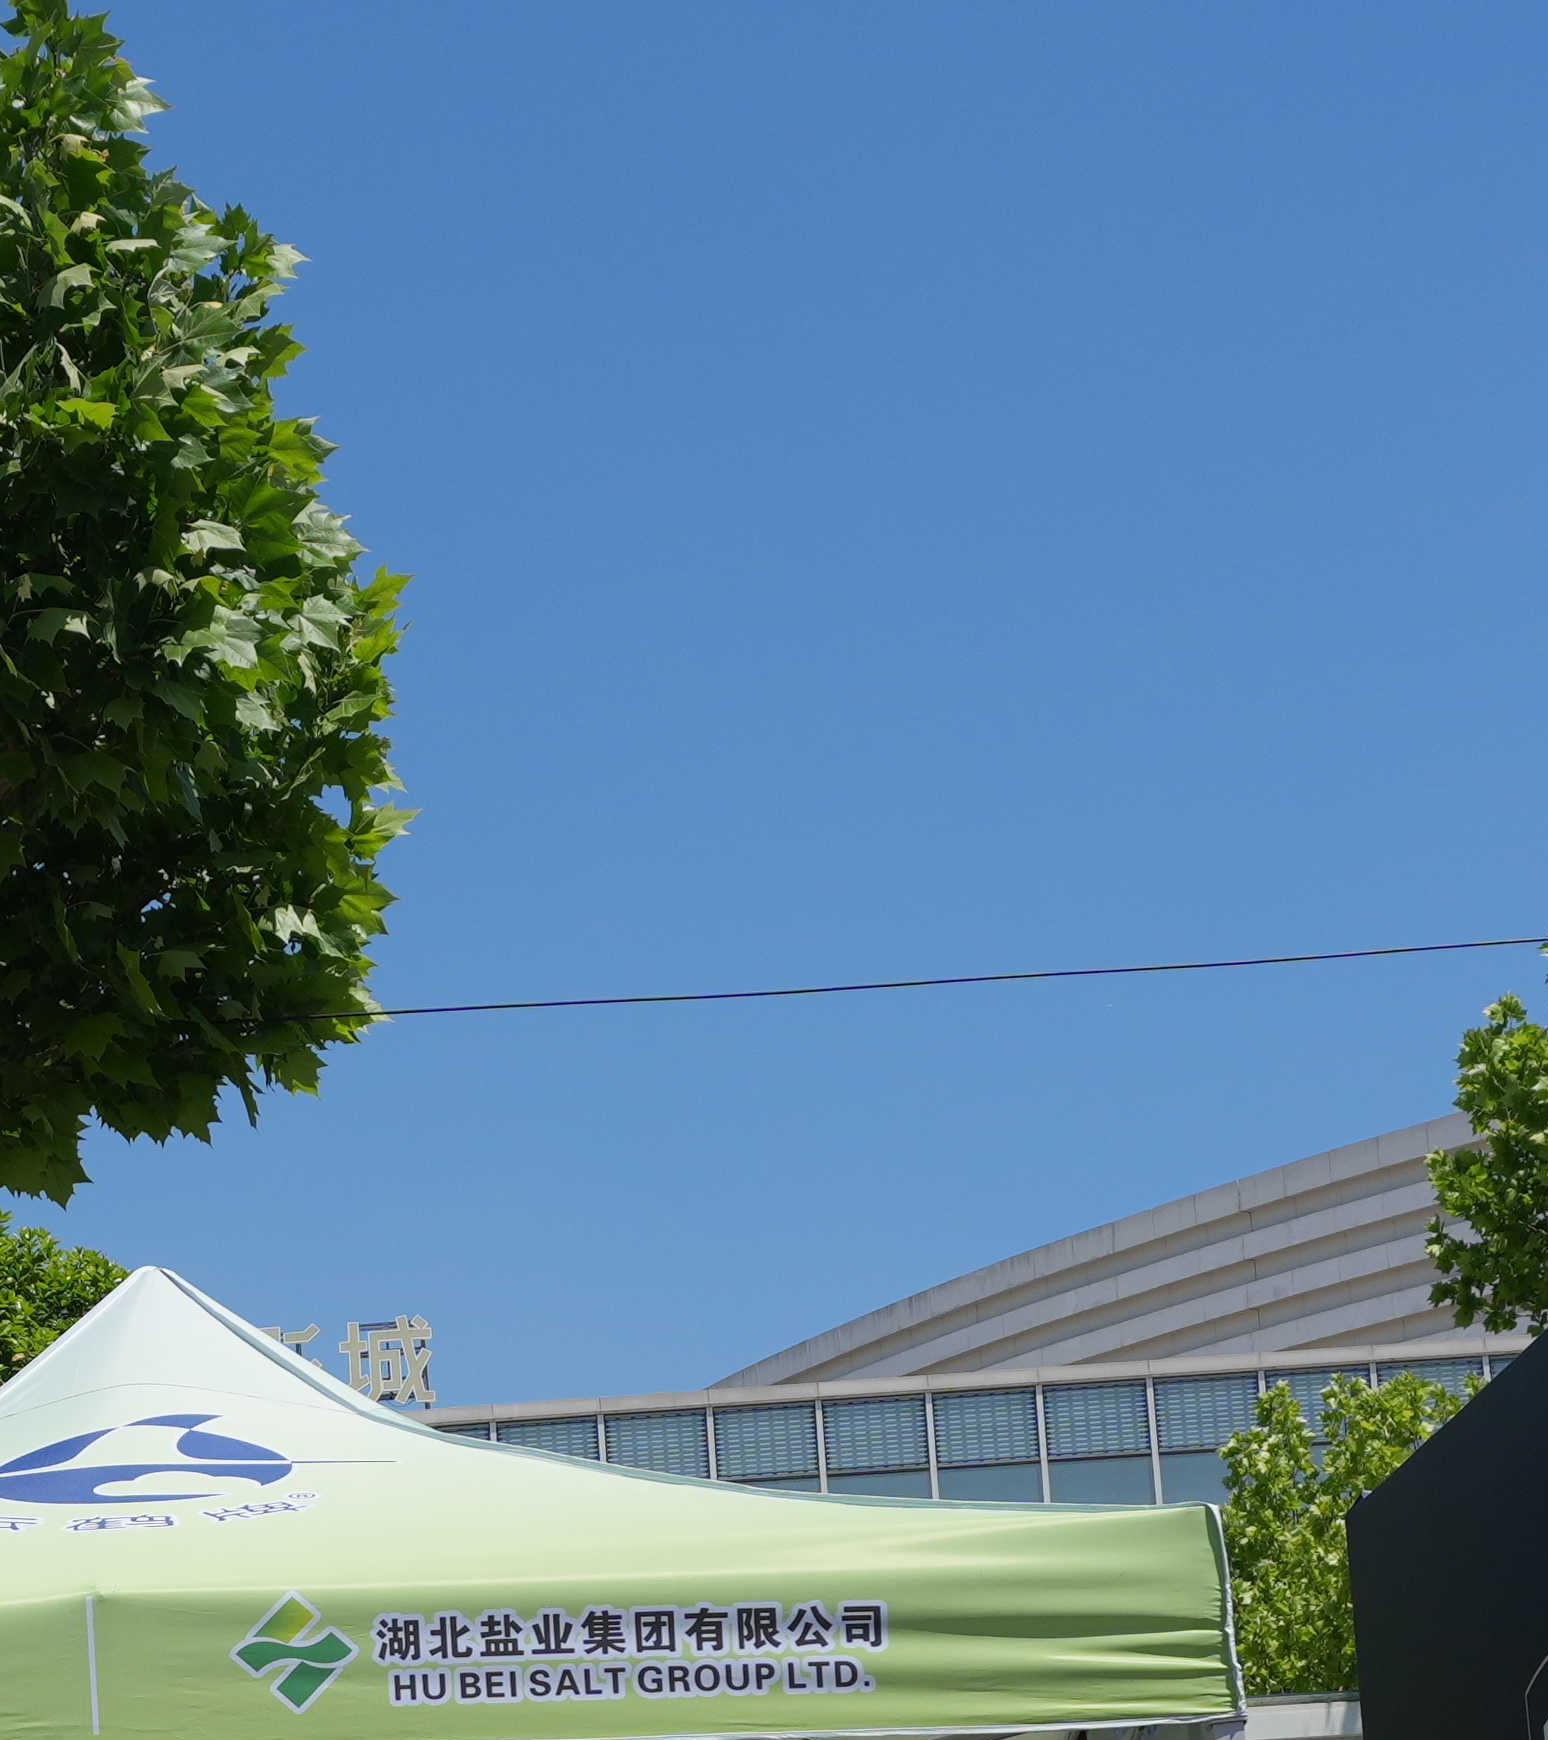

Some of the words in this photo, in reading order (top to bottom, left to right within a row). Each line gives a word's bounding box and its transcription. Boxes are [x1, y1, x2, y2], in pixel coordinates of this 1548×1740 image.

[376, 1603, 884, 1664] 湖北盐业集团有限公司
[529, 1668, 626, 1700] SALT
[636, 1663, 776, 1697] GROUP
[788, 1661, 870, 1691] LTD.
